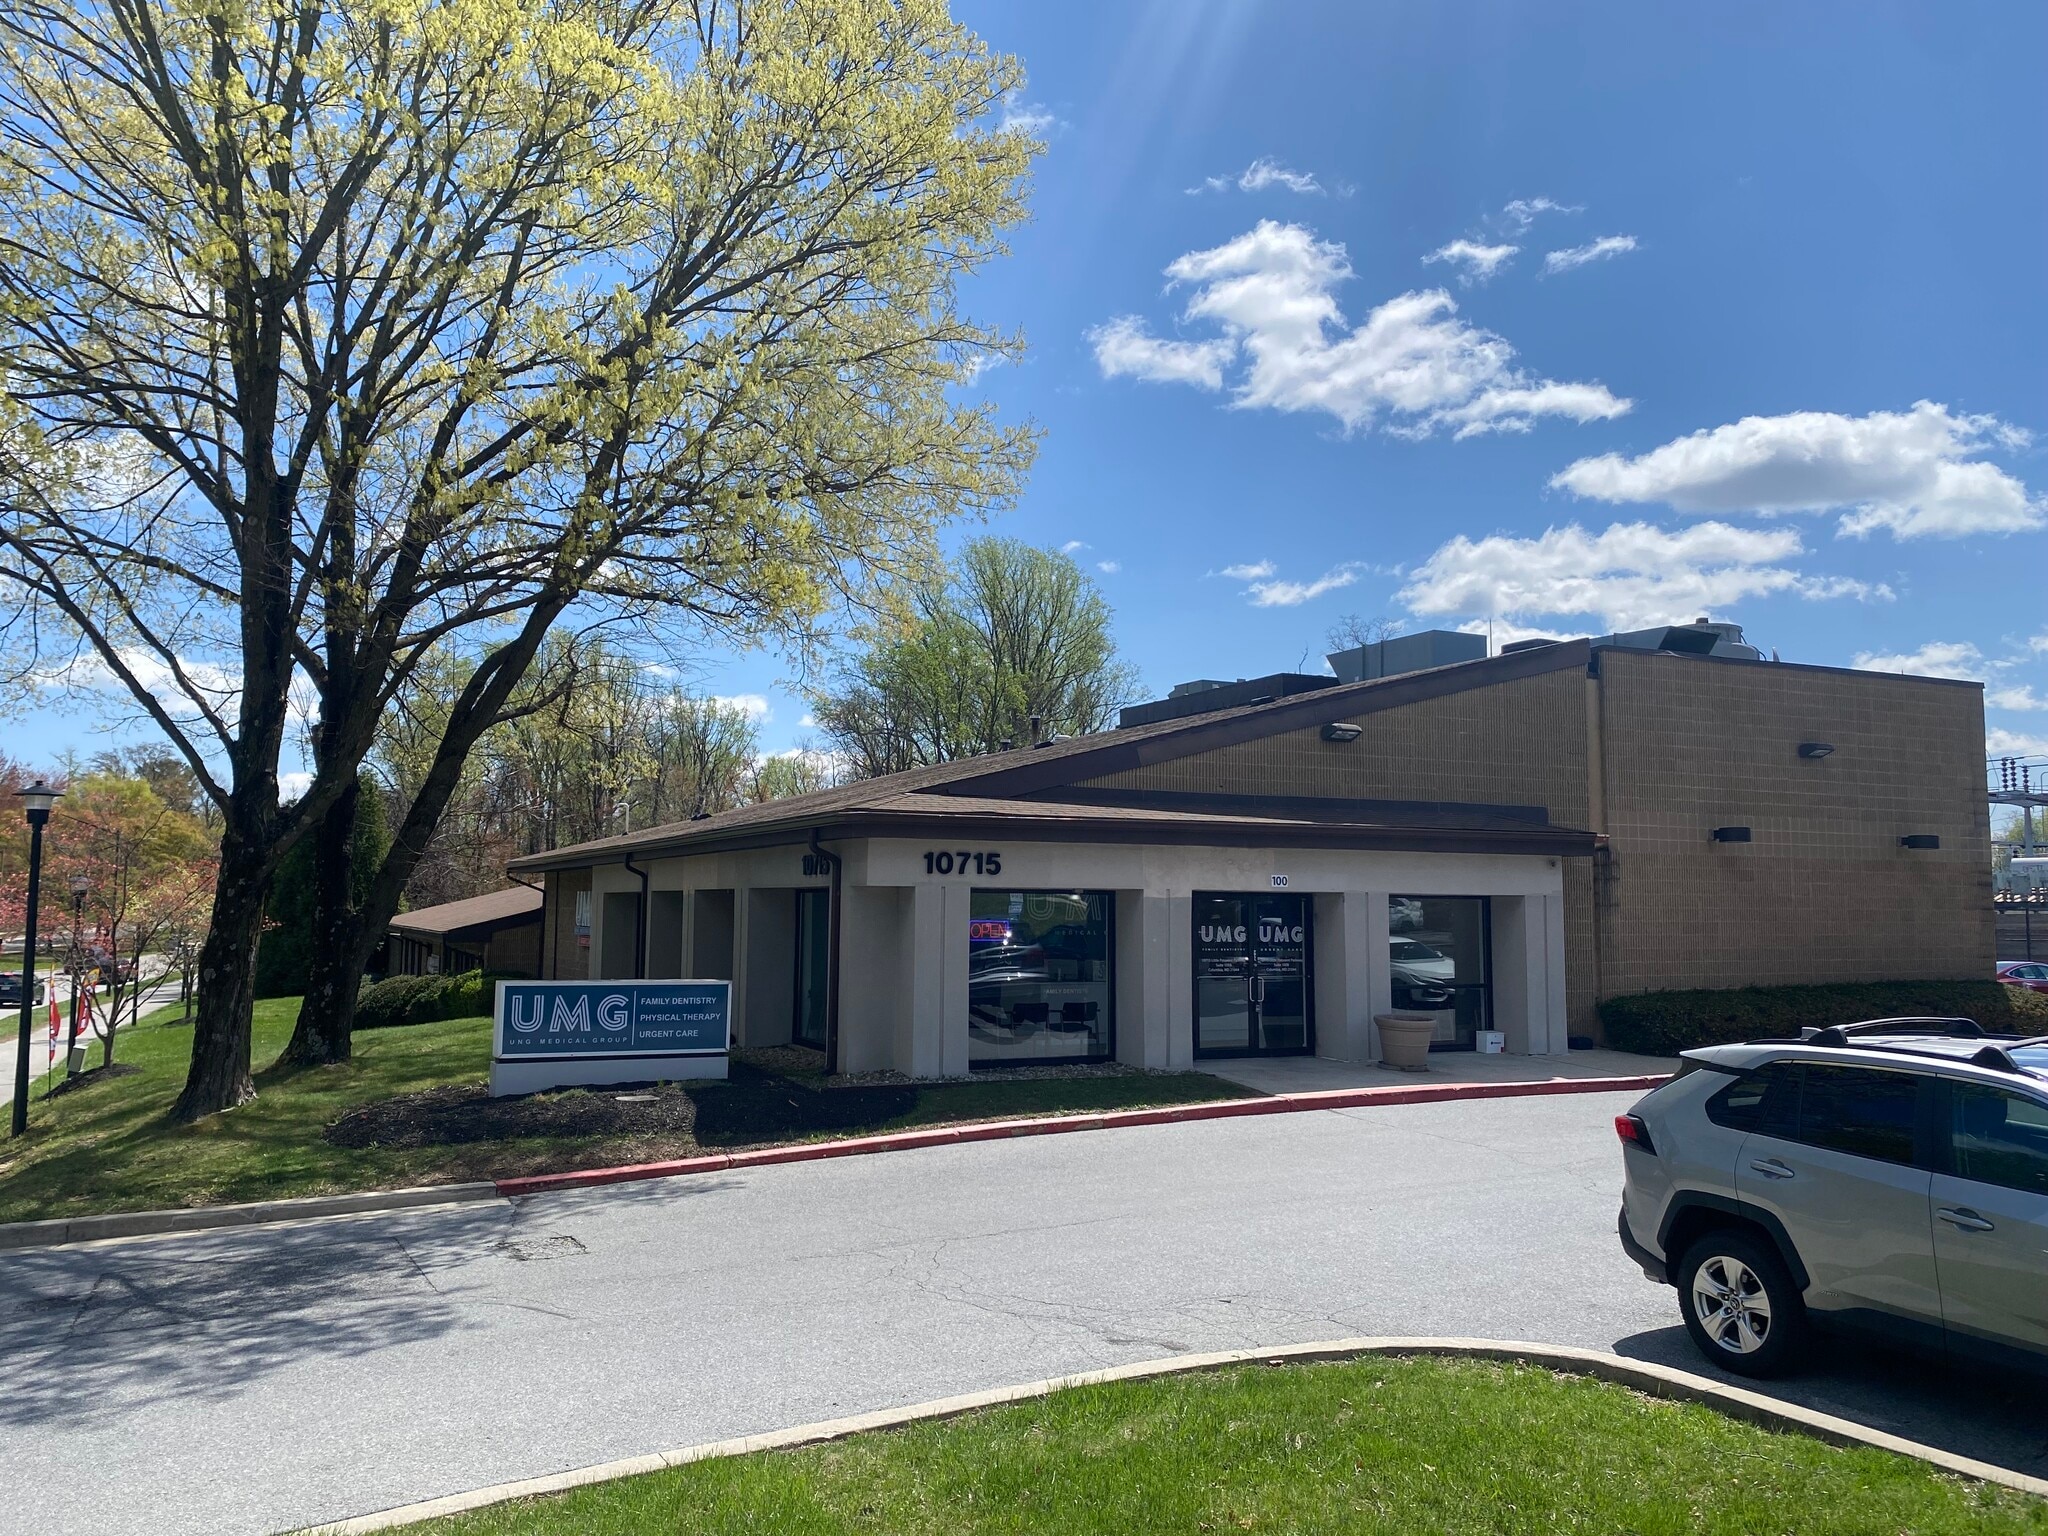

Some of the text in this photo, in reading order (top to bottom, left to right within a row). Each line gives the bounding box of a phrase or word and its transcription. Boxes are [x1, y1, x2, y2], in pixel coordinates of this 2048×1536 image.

[923, 852, 1002, 875] 10715
[1271, 876, 1288, 886] 100
[970, 923, 1007, 938] OPEN
[1200, 925, 1247, 943] UMG
[1259, 925, 1303, 943] UMG
[640, 996, 717, 1005] FAMILY DENTISTRY
[511, 994, 630, 1033] UMG
[640, 1012, 721, 1022] PHYSICAL THERAPY
[639, 1029, 699, 1038] URGENT CARE
[540, 1037, 587, 1045] MEDICAL
[592, 1036, 628, 1044] GROUP
